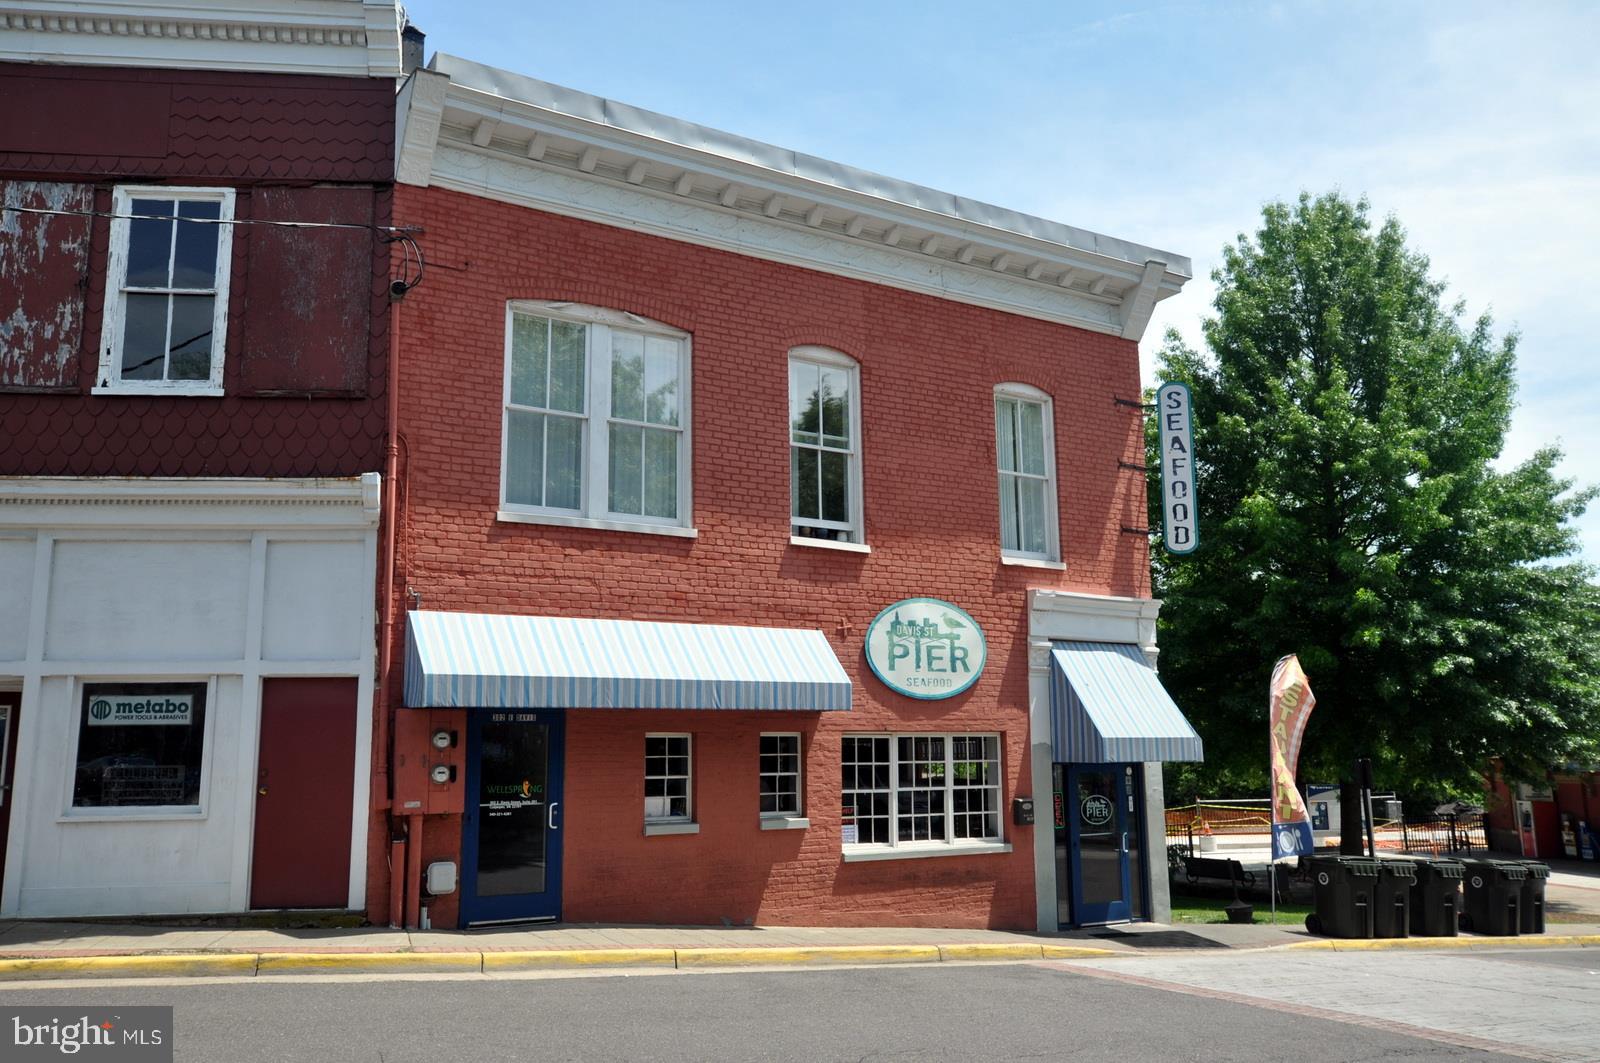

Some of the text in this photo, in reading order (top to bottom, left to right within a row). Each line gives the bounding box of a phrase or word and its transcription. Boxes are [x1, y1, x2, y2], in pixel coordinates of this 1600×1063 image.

[1166, 391, 1190, 545] SEAFOOD
[896, 624, 934, 637] DAVIS ST
[888, 641, 971, 673] PIER
[906, 677, 953, 689] SEAFOOD
[115, 699, 189, 714] metabo
[1086, 807, 1109, 817] PIER
